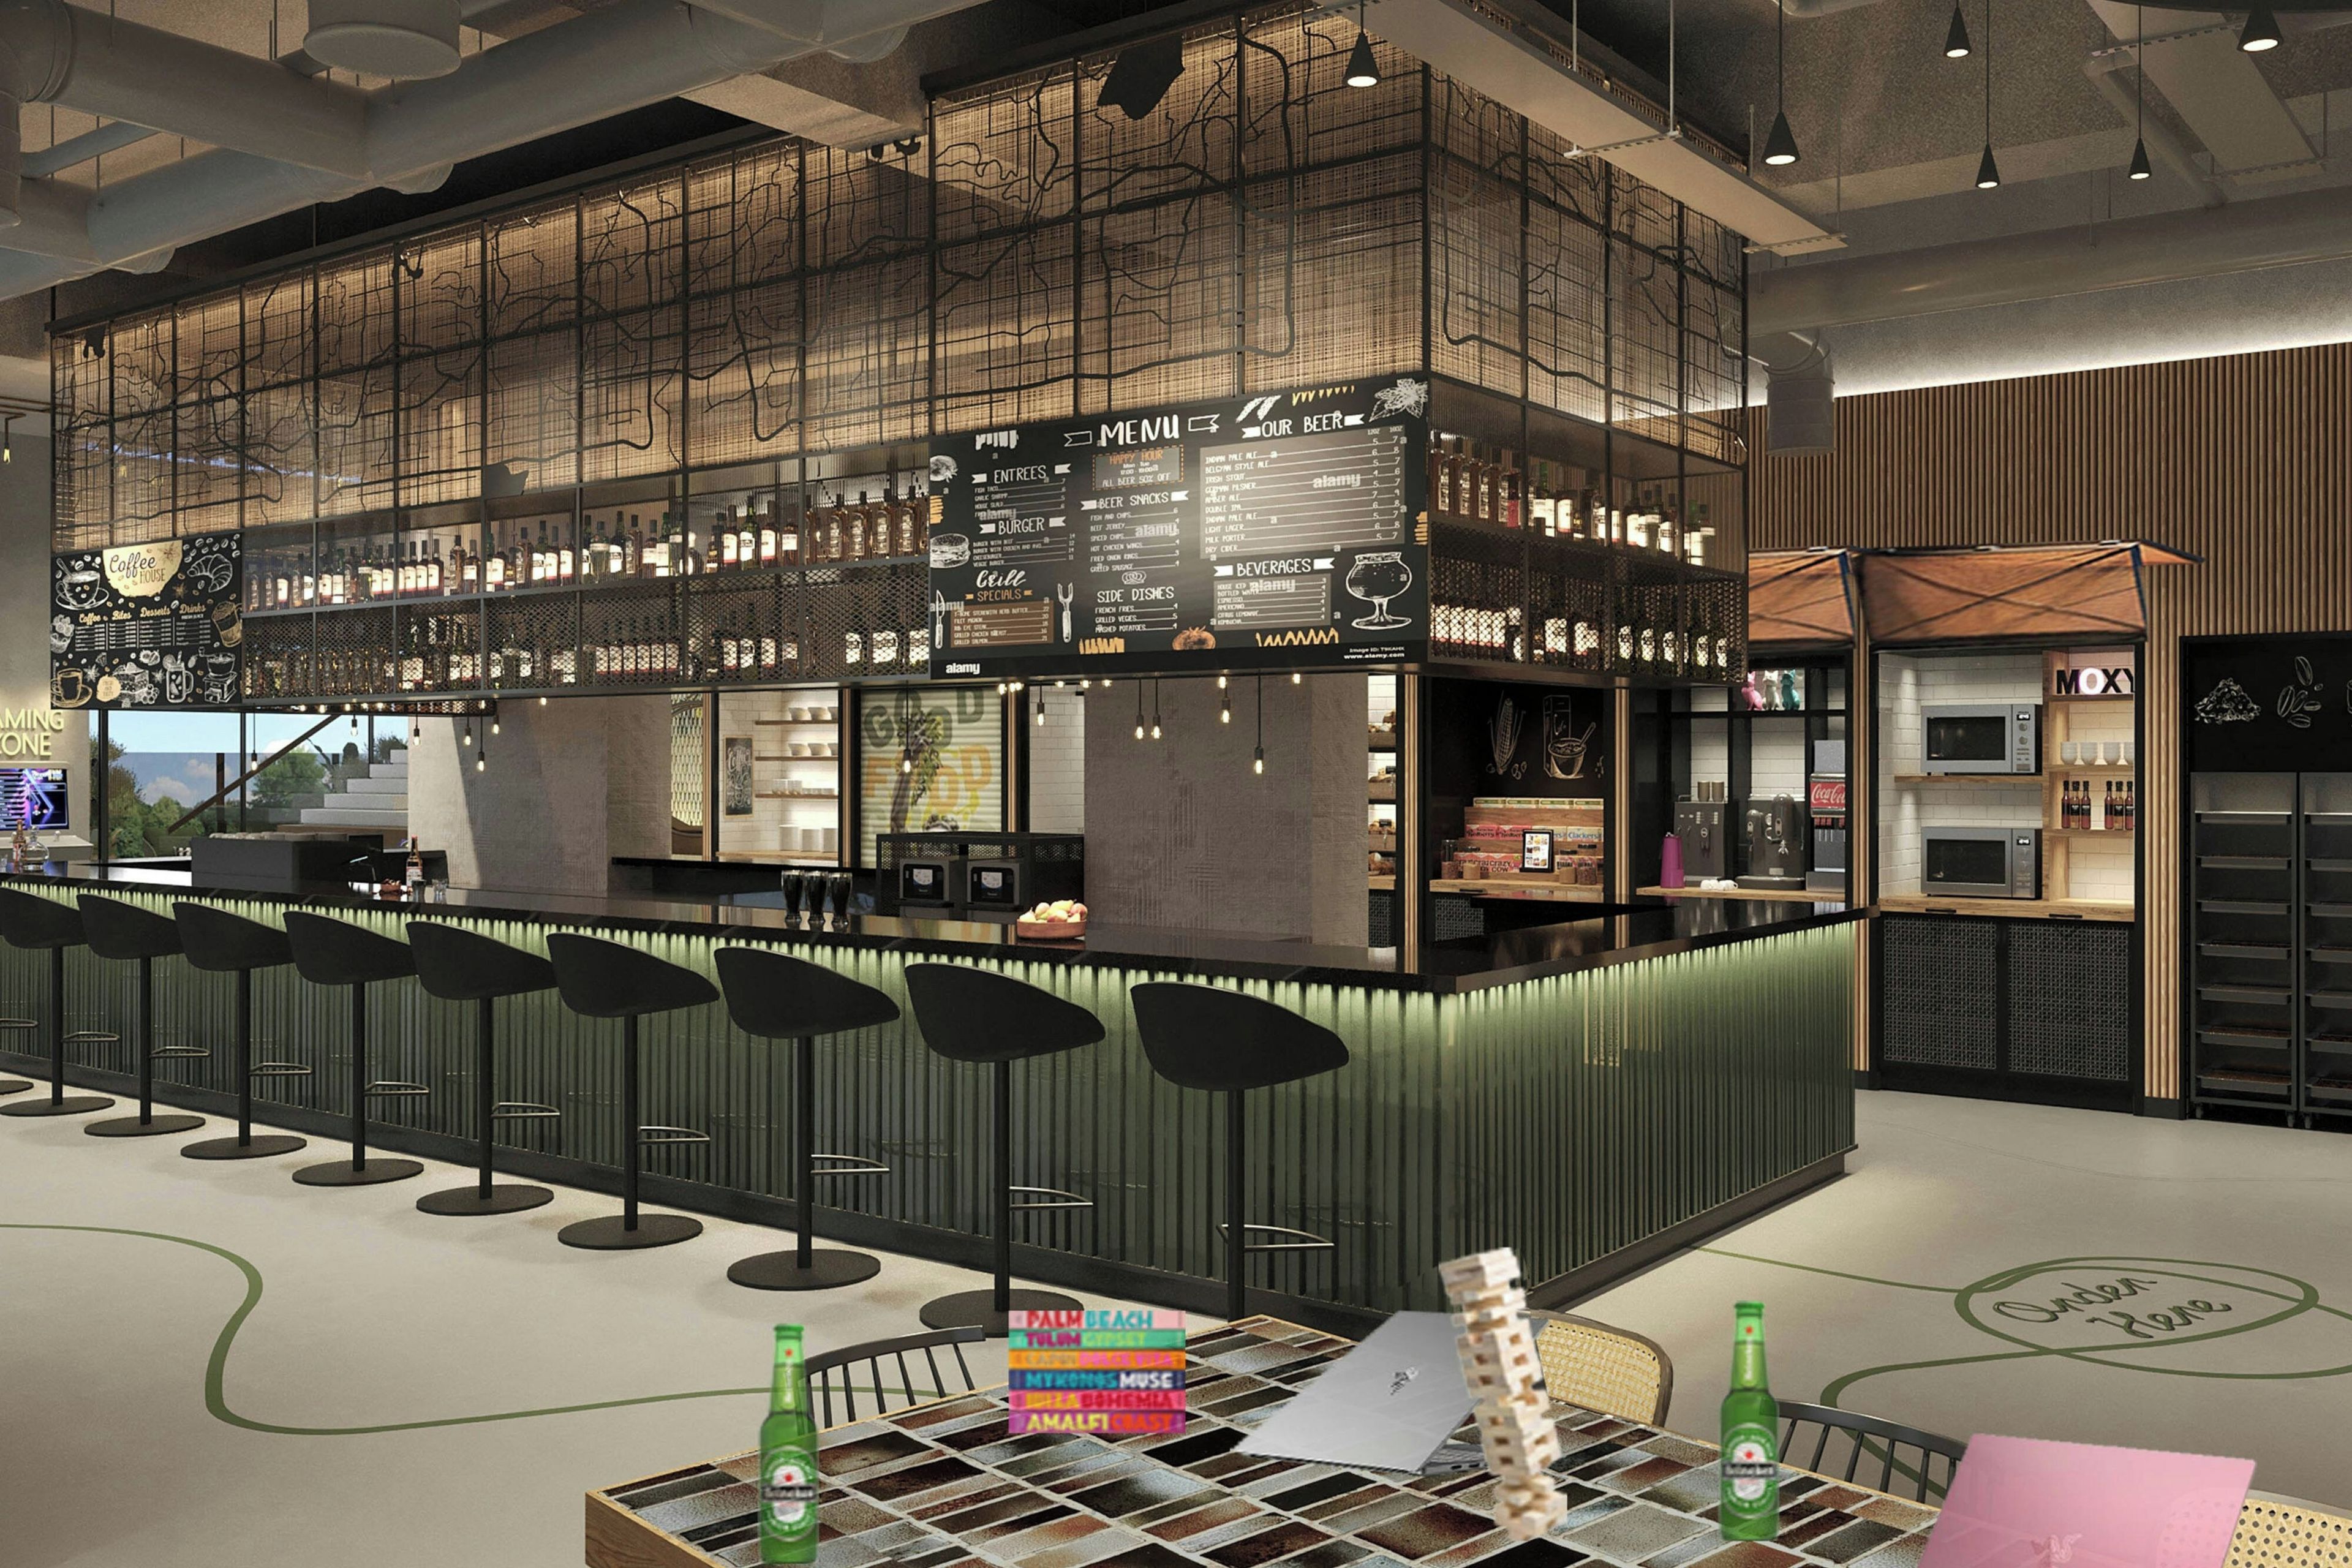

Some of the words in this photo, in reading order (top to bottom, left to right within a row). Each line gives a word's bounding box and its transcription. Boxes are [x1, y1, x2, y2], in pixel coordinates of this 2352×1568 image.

[1101, 414, 1179, 447] MENU
[1262, 419, 1292, 437] OUR
[1304, 413, 1343, 433] BEER
[1109, 453, 1136, 465] HAPPY
[1142, 450, 1163, 460] HOUR
[1229, 453, 1243, 461] PALE
[994, 465, 1046, 484] ENTREES
[1234, 462, 1254, 470] STYLE
[1118, 477, 1135, 486] BEER
[1157, 472, 1170, 481] OFF
[1226, 473, 1245, 481] STOUT
[1313, 473, 1361, 488] alamy
[1099, 497, 1123, 509] BEER
[1130, 492, 1169, 506] SNACKS
[998, 517, 1045, 535] BURGER
[1135, 522, 1177, 537] alamy
[109, 552, 157, 579] Coffee
[1237, 559, 1311, 576] BEVERAGES
[140, 568, 166, 584] HOUSE
[976, 569, 1027, 588] Grill
[1097, 589, 1125, 603] SIDE
[1132, 586, 1174, 601] DISHES
[1251, 579, 1295, 593] alamy
[977, 589, 1022, 601] SPECIALS
[79, 612, 101, 625] Coffee
[112, 610, 132, 620] Bites
[140, 605, 171, 617] Desserts
[179, 603, 206, 614] Drinks
[946, 663, 980, 674] alamy
[0, 707, 64, 731] MING
[0, 733, 52, 756] ONE
[865, 745, 991, 812] FOD
[1026, 1310, 1083, 1329] PALM
[1085, 1310, 1153, 1329] BEACH
[1025, 1332, 1081, 1347] TULUM
[1079, 1352, 1131, 1366] DOLCE
[1136, 1352, 1174, 1366] VITA
[1025, 1371, 1119, 1389] MYKONOS
[1120, 1371, 1173, 1389] MUSE
[1081, 1393, 1174, 1408] BOHEMIA
[1027, 1412, 1109, 1430] AMALFI
[1110, 1413, 1173, 1430] COAST
